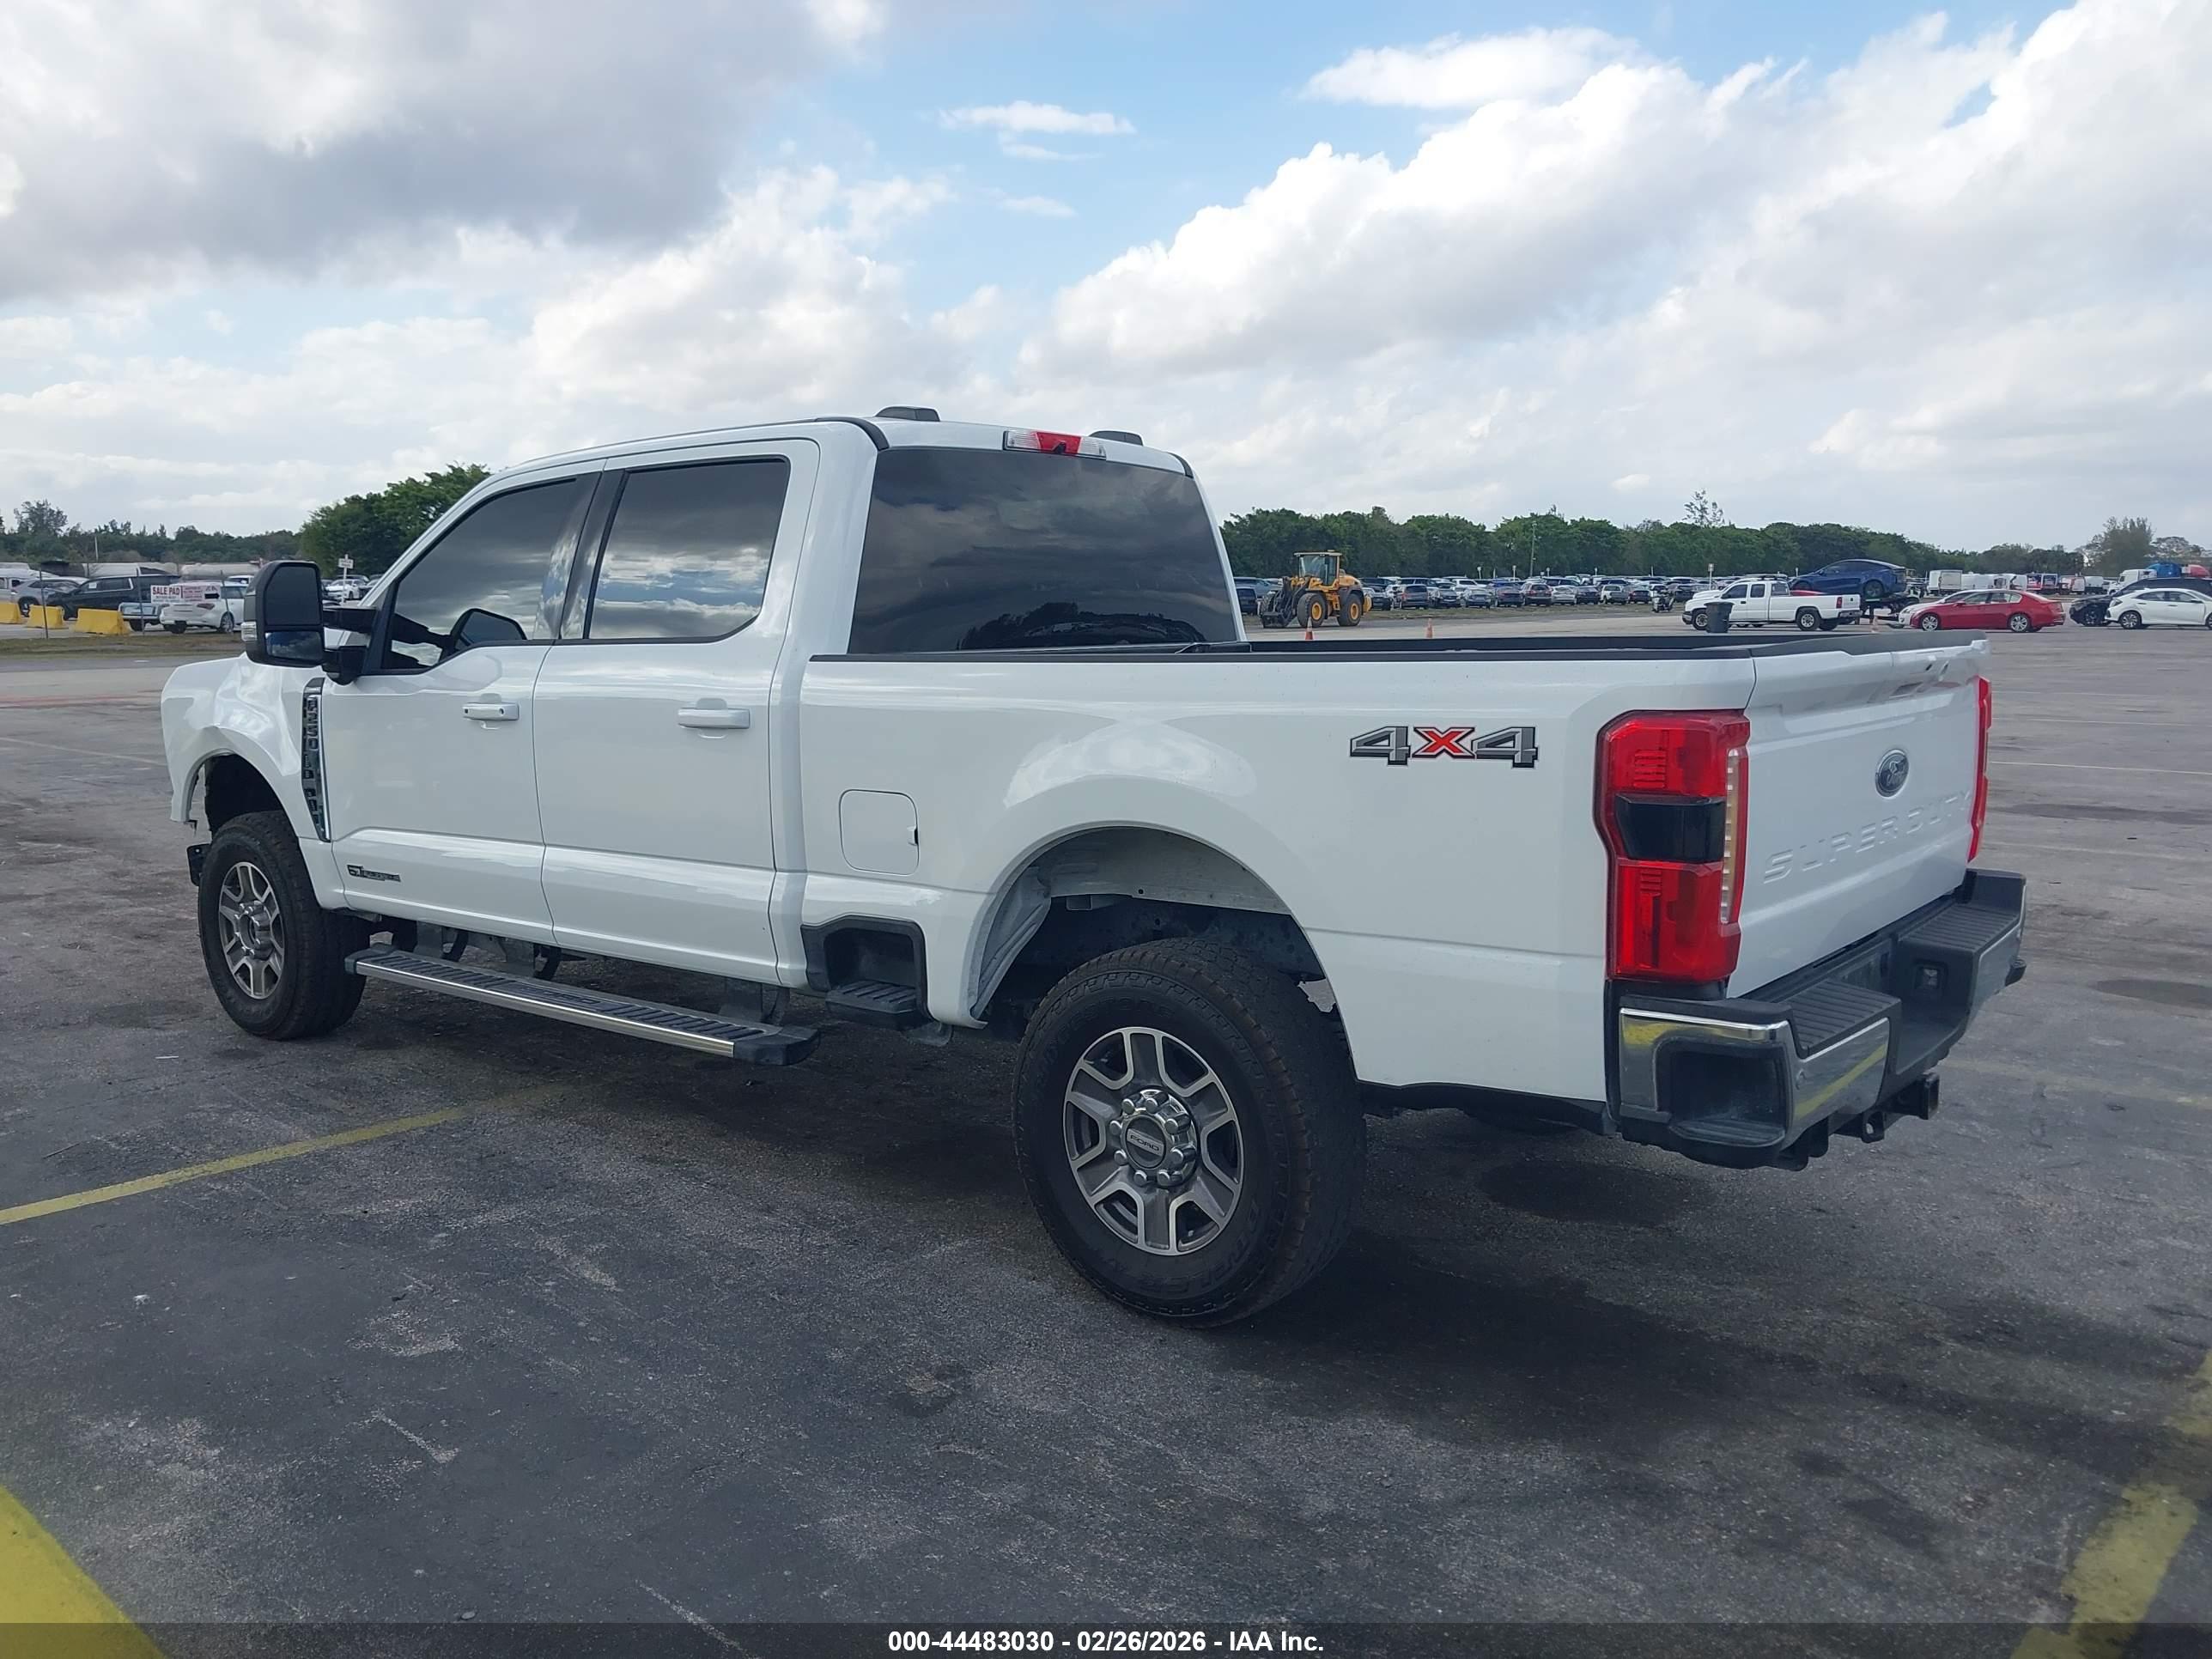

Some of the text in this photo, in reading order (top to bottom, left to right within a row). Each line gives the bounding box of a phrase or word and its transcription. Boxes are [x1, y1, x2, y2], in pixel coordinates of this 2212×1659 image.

[152, 586, 167, 595] SALE
[168, 586, 180, 595] PAD
[1350, 726, 1538, 768] 4X4
[1764, 816, 1900, 884] SUPER
[1130, 1133, 1160, 1152] FORD
